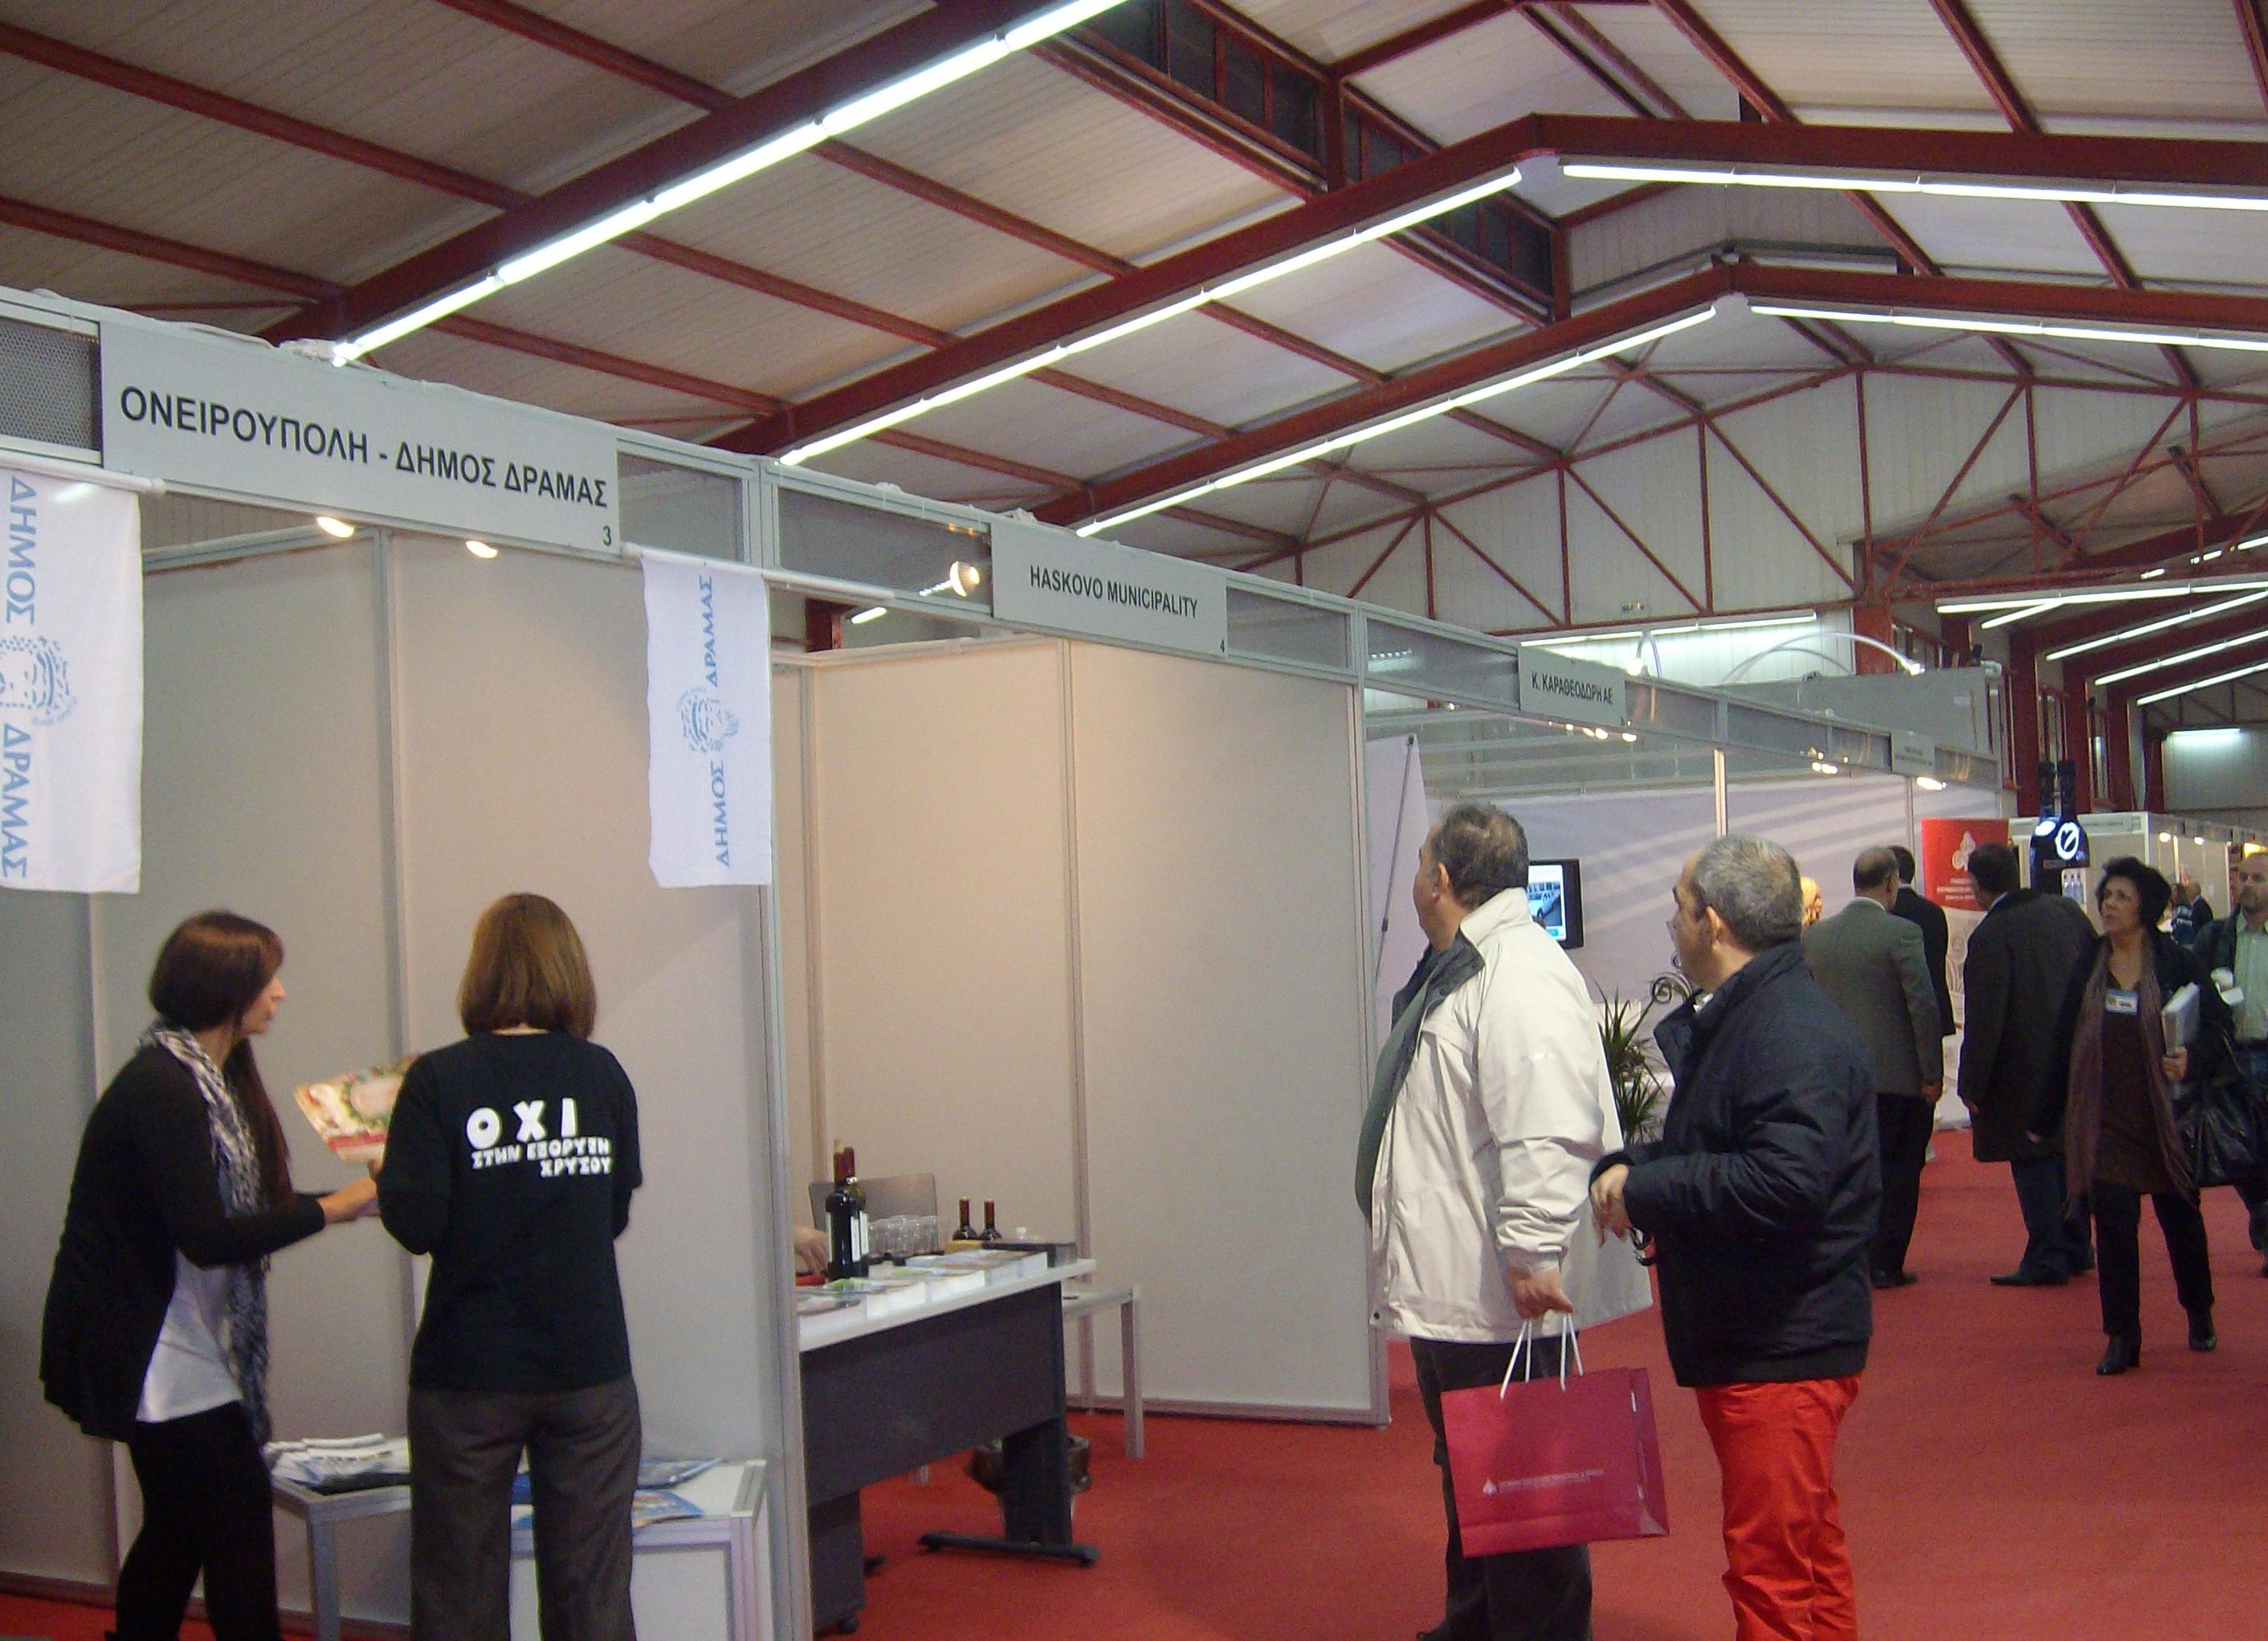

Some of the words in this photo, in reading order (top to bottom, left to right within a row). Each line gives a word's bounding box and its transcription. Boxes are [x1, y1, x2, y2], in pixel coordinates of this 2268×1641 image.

[120, 385, 369, 463] ΟΝΕΙΡΟΥΠΟΛΗ
[396, 441, 496, 488] ΔΗΜΟΣ
[504, 462, 608, 508] ΔΡΑΜΑΣ
[6, 476, 37, 626] ΔΗΜΟΣ
[602, 525, 612, 547] 3
[1030, 564, 1103, 600] HASKOVO
[1107, 580, 1198, 618] MUNICIPALITY
[699, 574, 719, 688] ΔΡΑΜΑΣ
[1219, 639, 1226, 654] 4
[1542, 672, 1602, 703] ΚΑΡΑΘΕΟΔΩΡΗ
[1, 724, 31, 879] ΔΡΑΜΑΣ
[710, 761, 730, 868] ΔΗΜΟΣ
[467, 1097, 578, 1150] ΟΧΙ
[471, 1143, 522, 1170] ΣΤΗΝ
[527, 1136, 611, 1161] ΕΞΟΡΥΞΗ
[540, 1156, 612, 1178] ΧΡΥΣΟΥ
